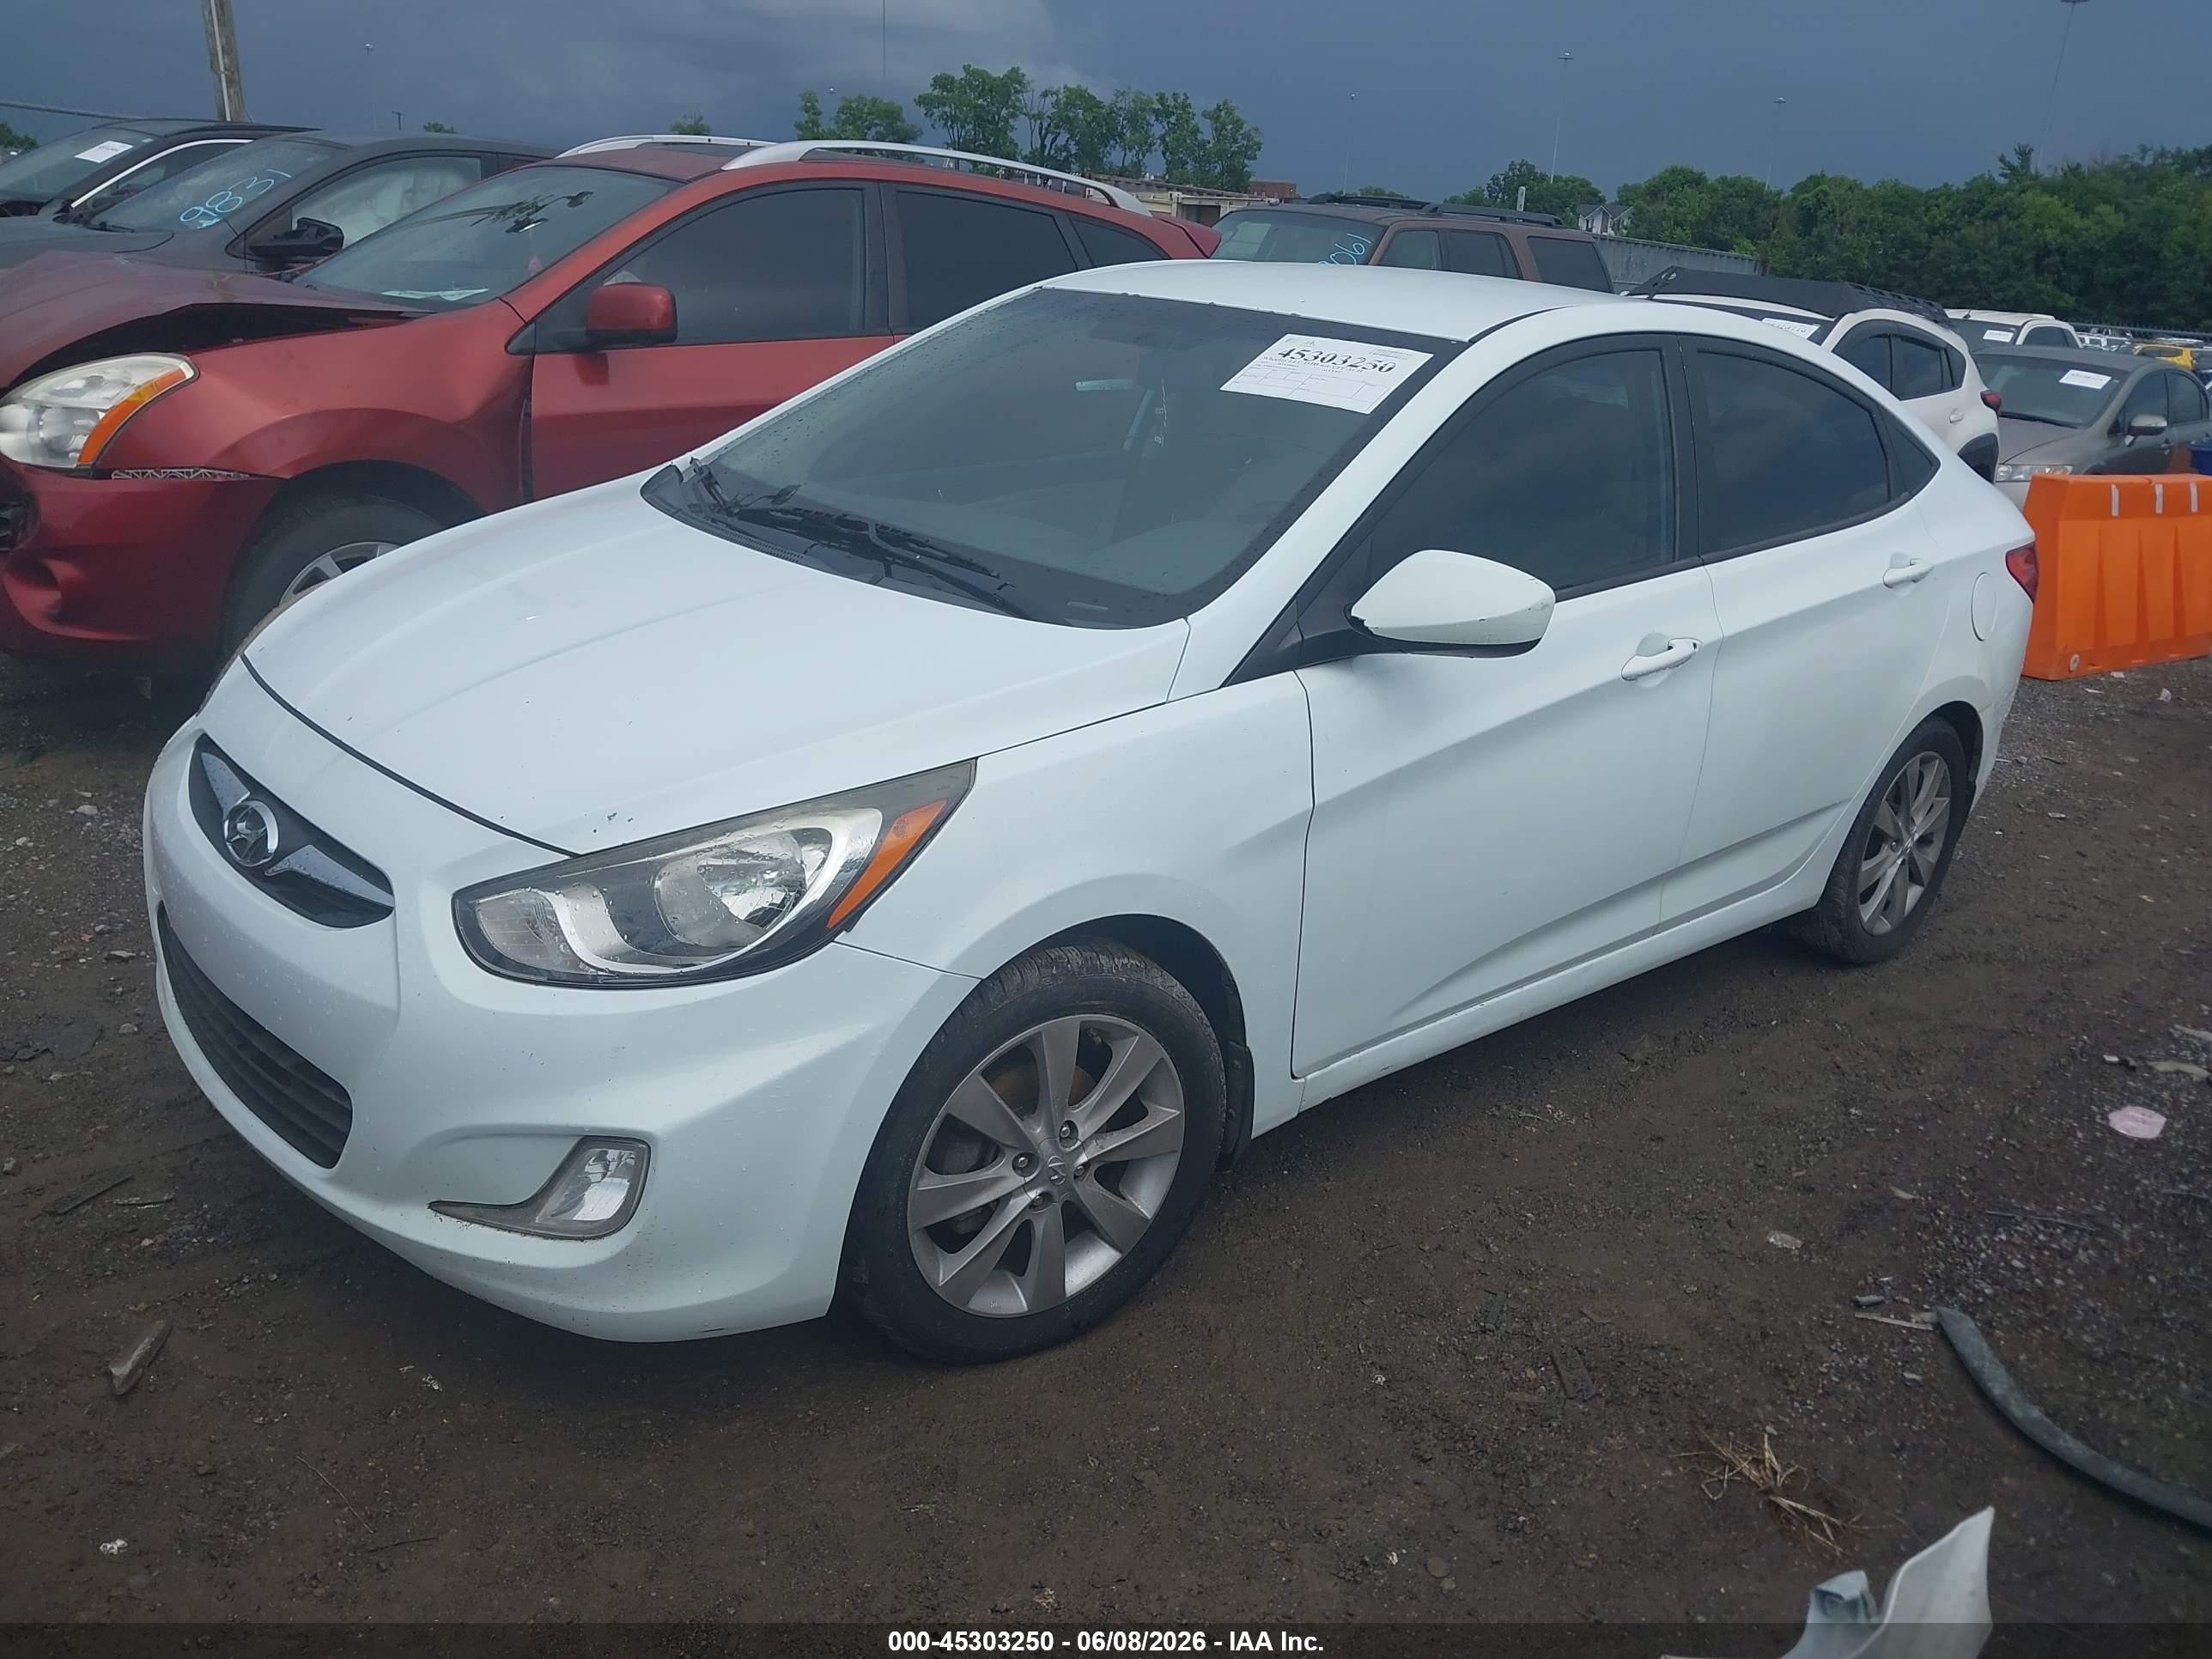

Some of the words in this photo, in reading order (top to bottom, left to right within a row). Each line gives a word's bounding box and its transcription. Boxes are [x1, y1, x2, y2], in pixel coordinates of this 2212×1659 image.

[179, 168, 293, 223] 9831
[1318, 233, 1372, 266] 061
[1277, 347, 1397, 374] 45303250
